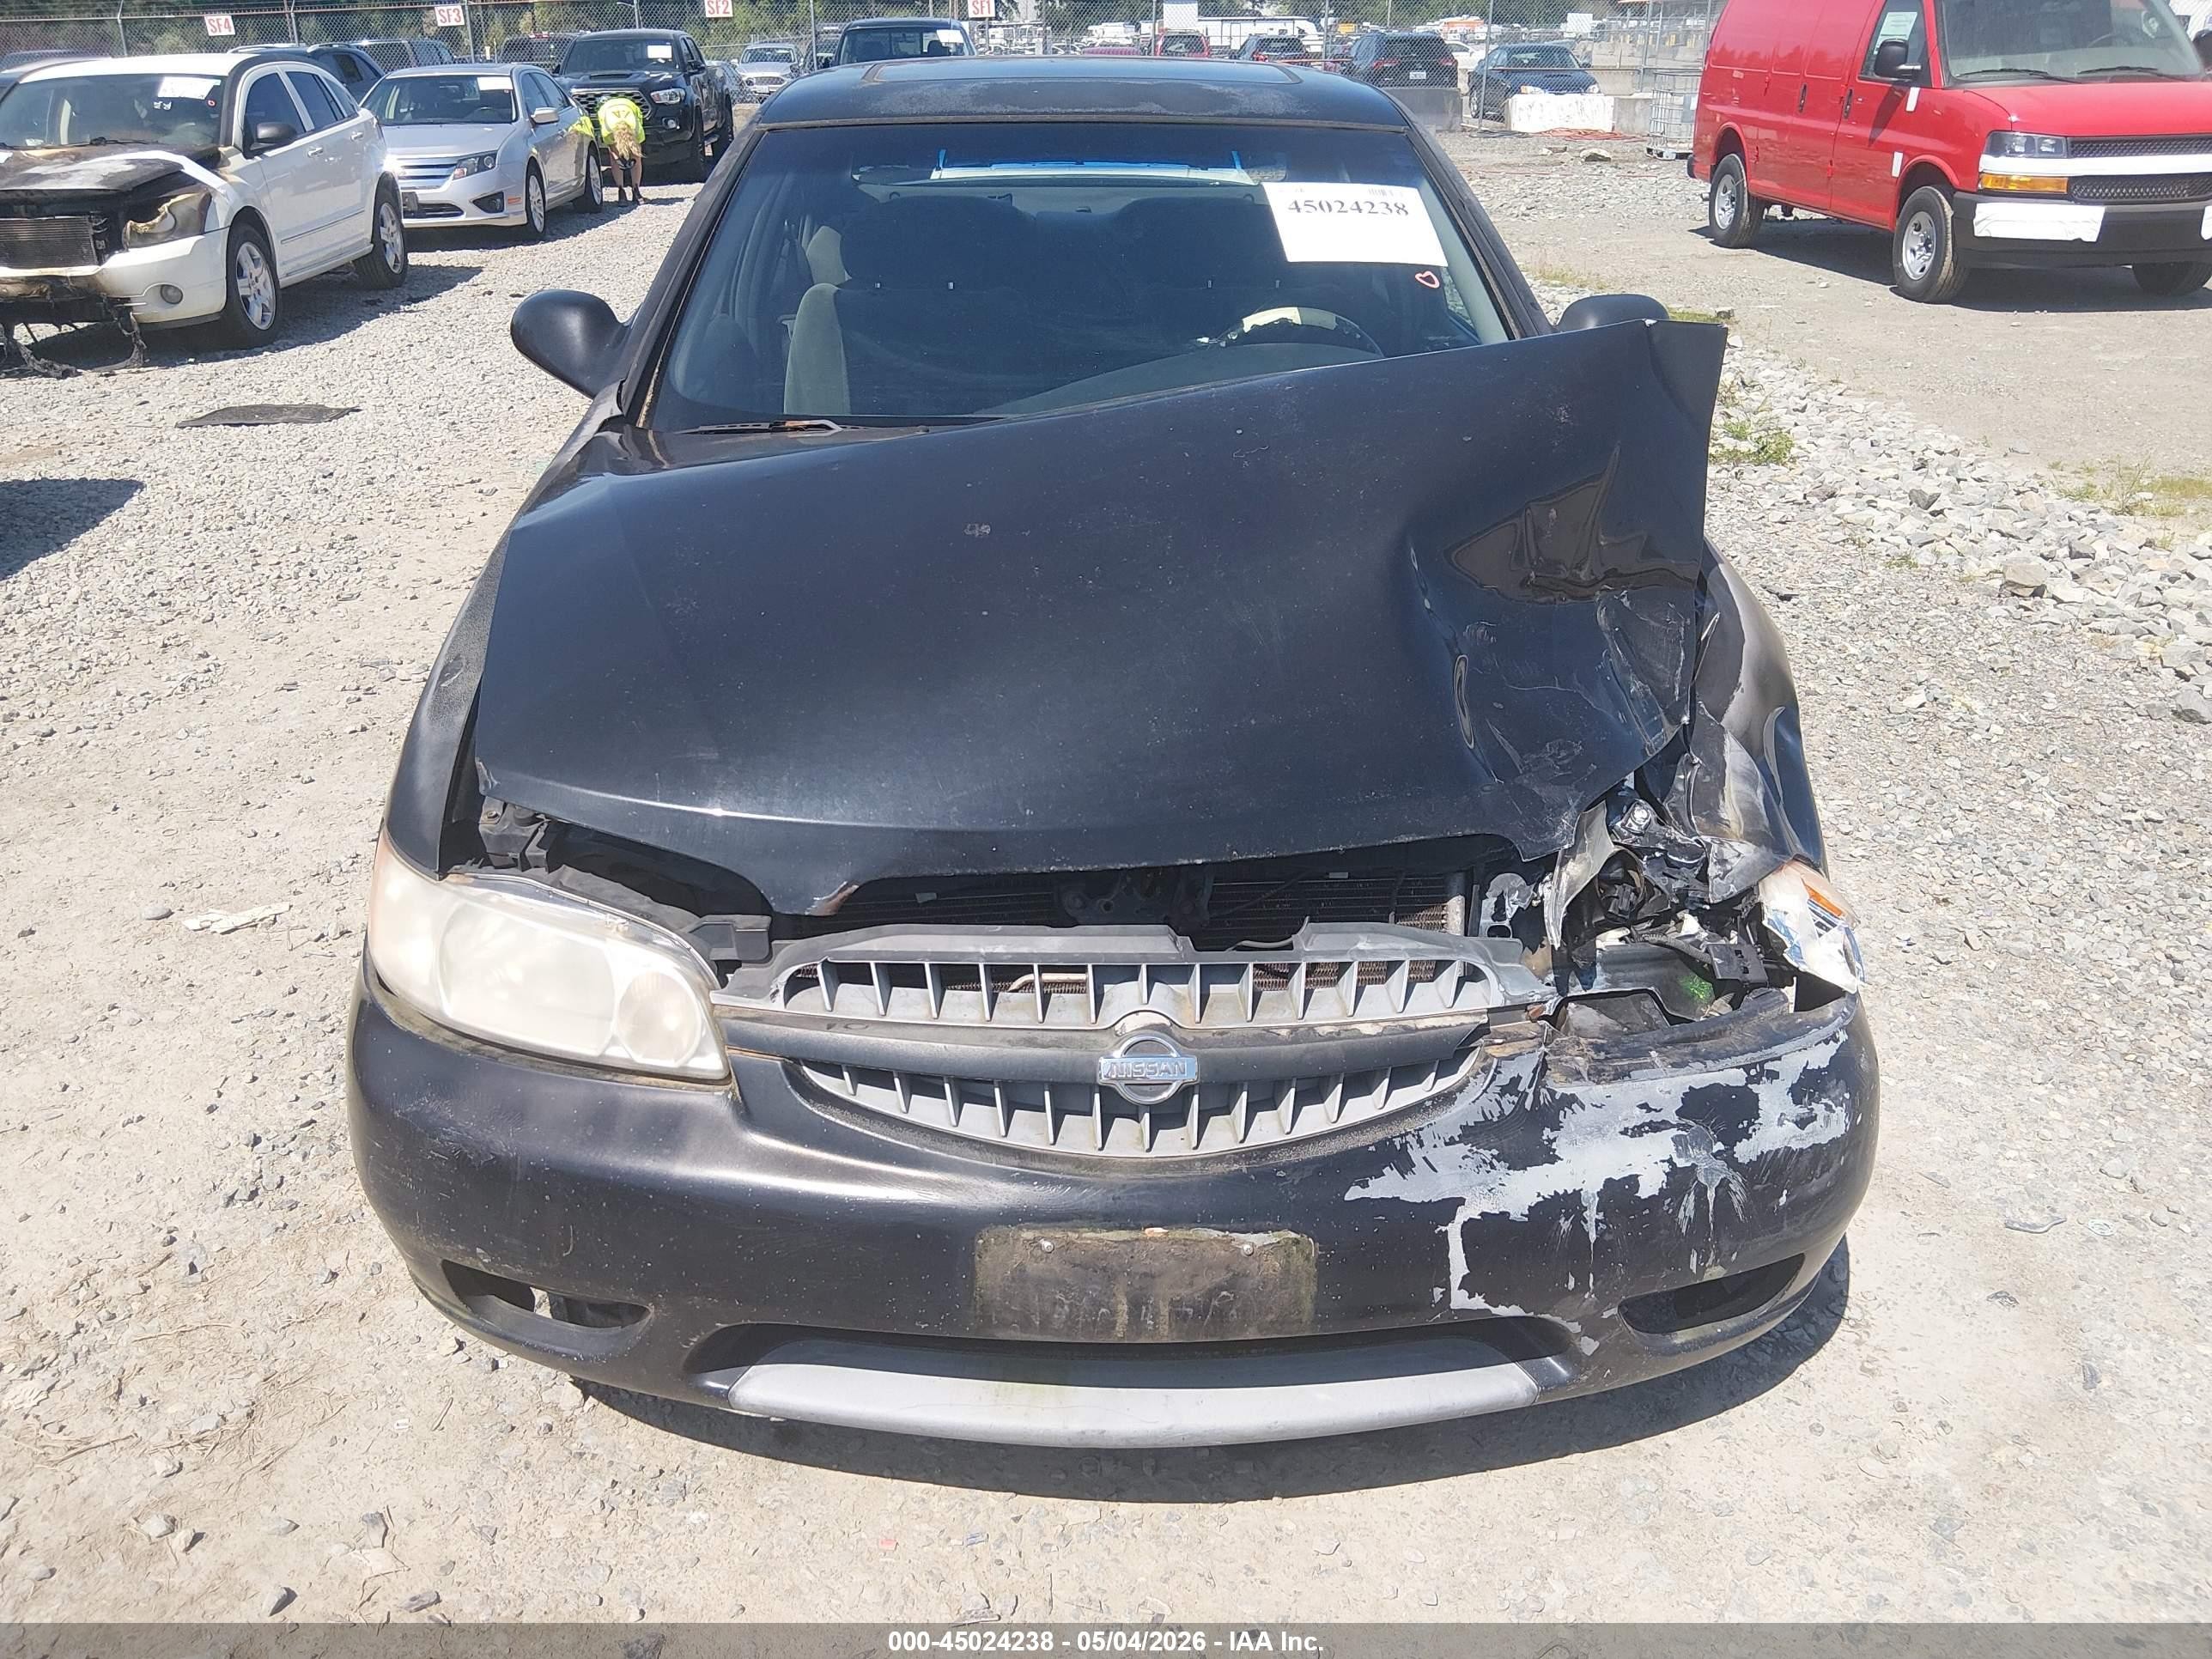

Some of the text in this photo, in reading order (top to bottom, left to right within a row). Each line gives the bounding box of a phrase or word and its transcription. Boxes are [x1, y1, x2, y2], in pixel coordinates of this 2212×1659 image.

[707, 0, 730, 15] SF2
[972, 0, 990, 15] SF1
[438, 8, 461, 23] SF3
[207, 18, 232, 33] SF4
[1288, 199, 1408, 216] 45024238
[1106, 1060, 1187, 1078] NISSAN
